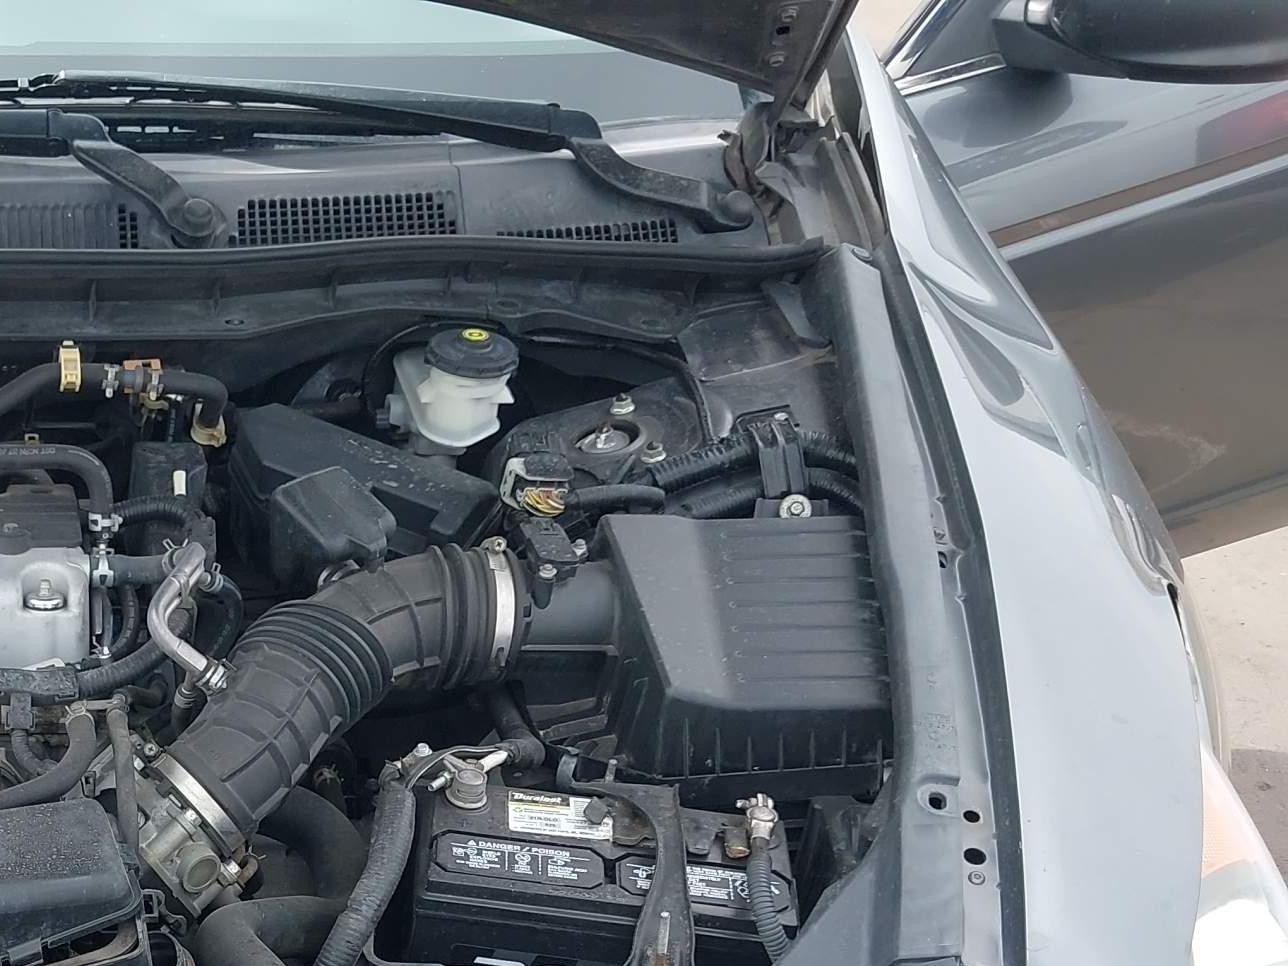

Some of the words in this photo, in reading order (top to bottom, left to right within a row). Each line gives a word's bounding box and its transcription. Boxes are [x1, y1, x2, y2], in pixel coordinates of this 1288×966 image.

[512, 792, 562, 804] Duralast
[478, 841, 521, 852] DANGER
[532, 847, 570, 858] POISON
